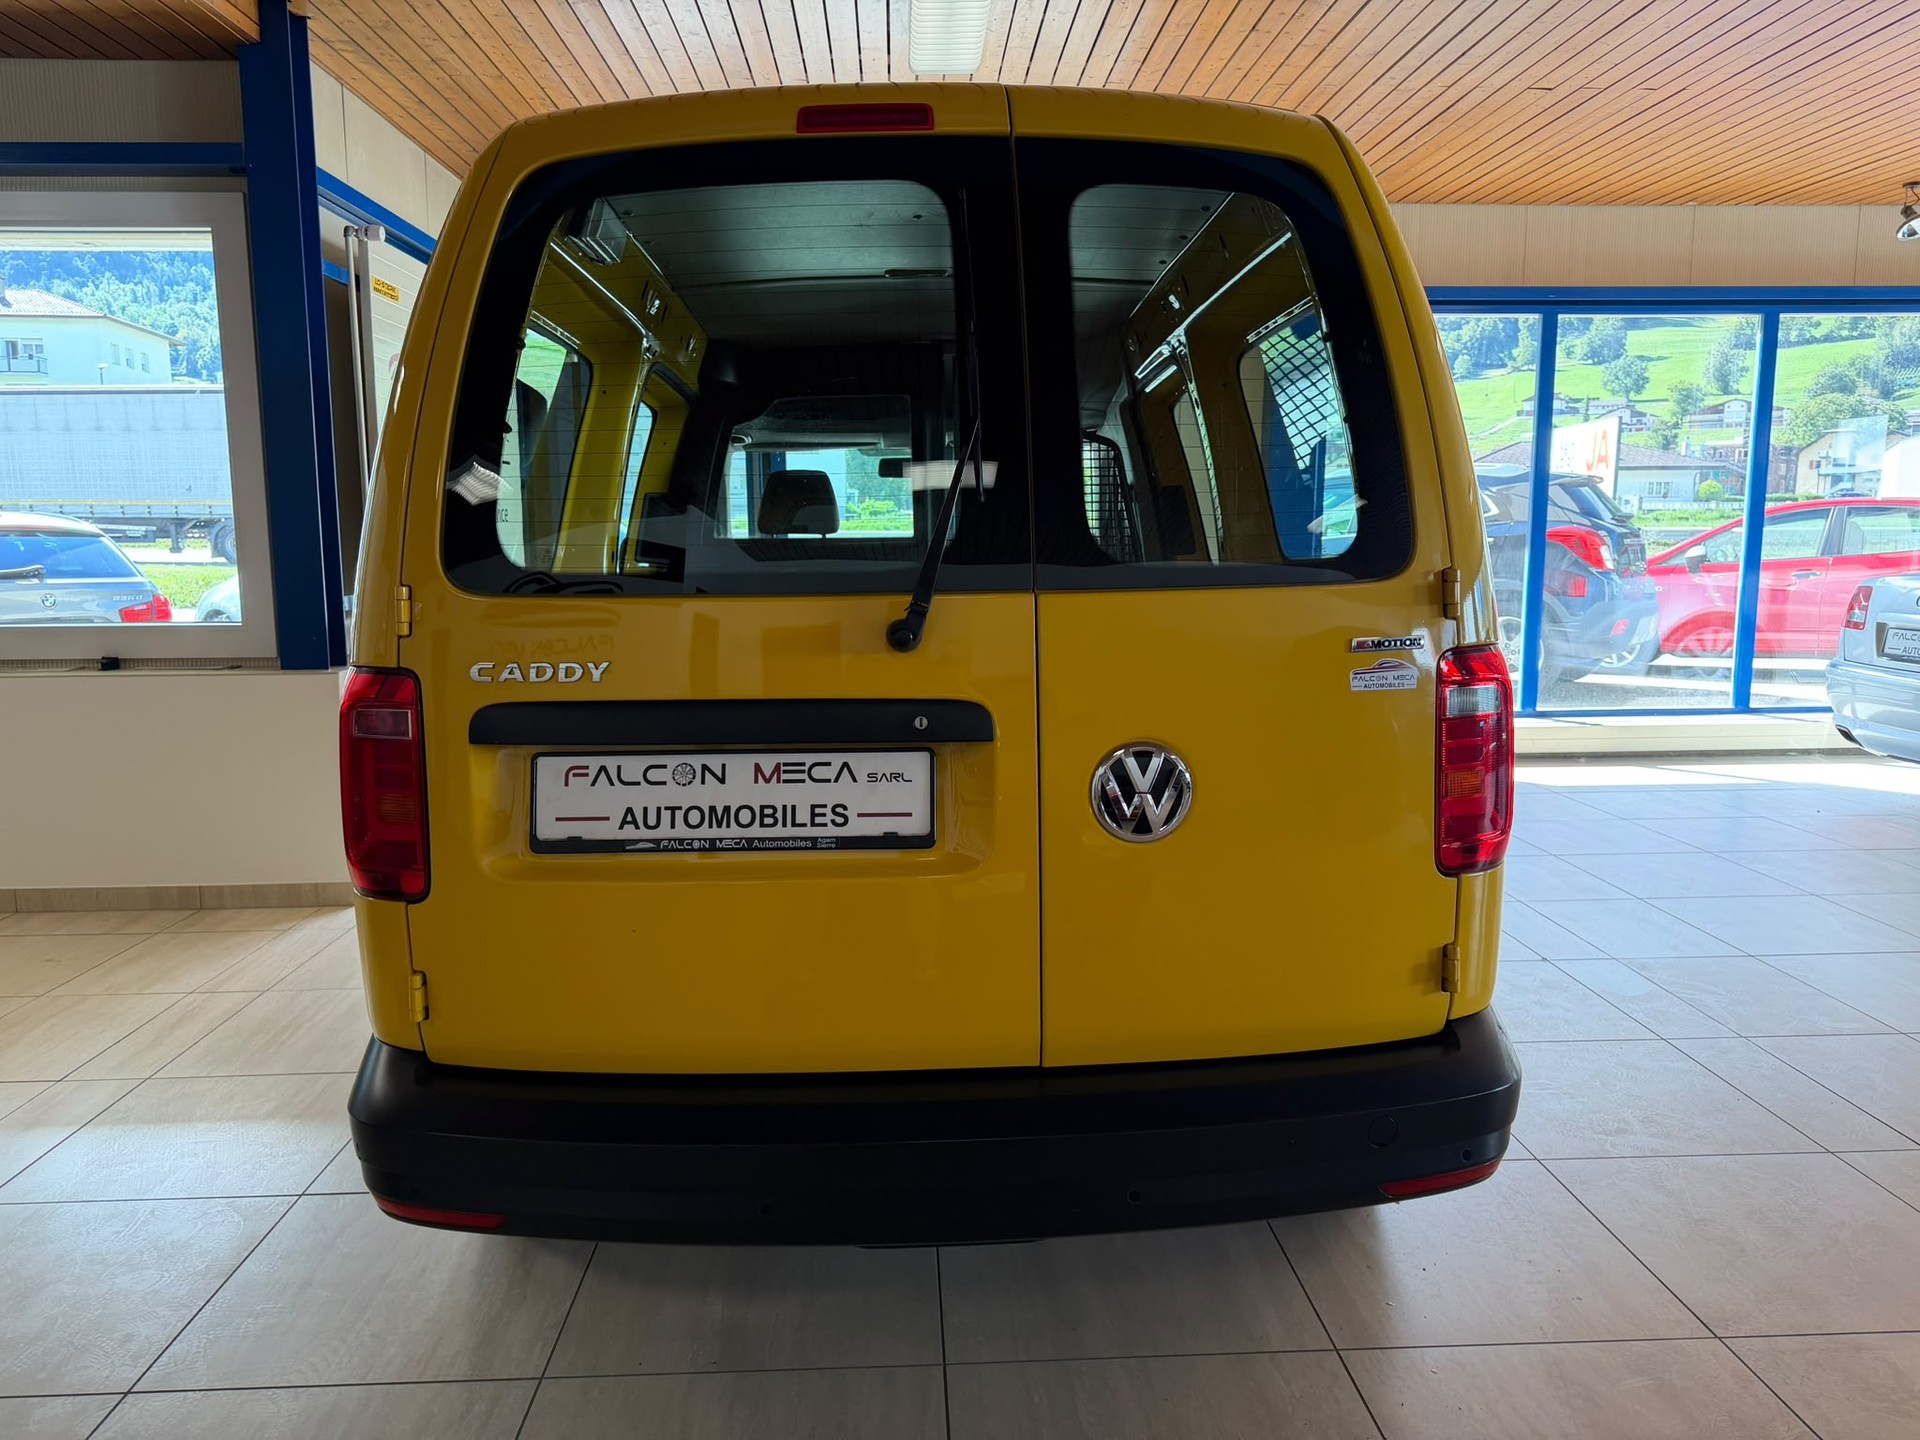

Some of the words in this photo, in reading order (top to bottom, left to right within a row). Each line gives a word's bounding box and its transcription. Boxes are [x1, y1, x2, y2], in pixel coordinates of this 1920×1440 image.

[469, 661, 611, 683] CADDY
[564, 762, 726, 787] FALCON
[753, 761, 858, 784] MECA
[866, 772, 913, 783] SARL
[617, 803, 850, 831] AUTOMOBILES
[660, 840, 709, 849] FALCON
[716, 839, 748, 849] MECA
[752, 838, 812, 848] Automobiles
